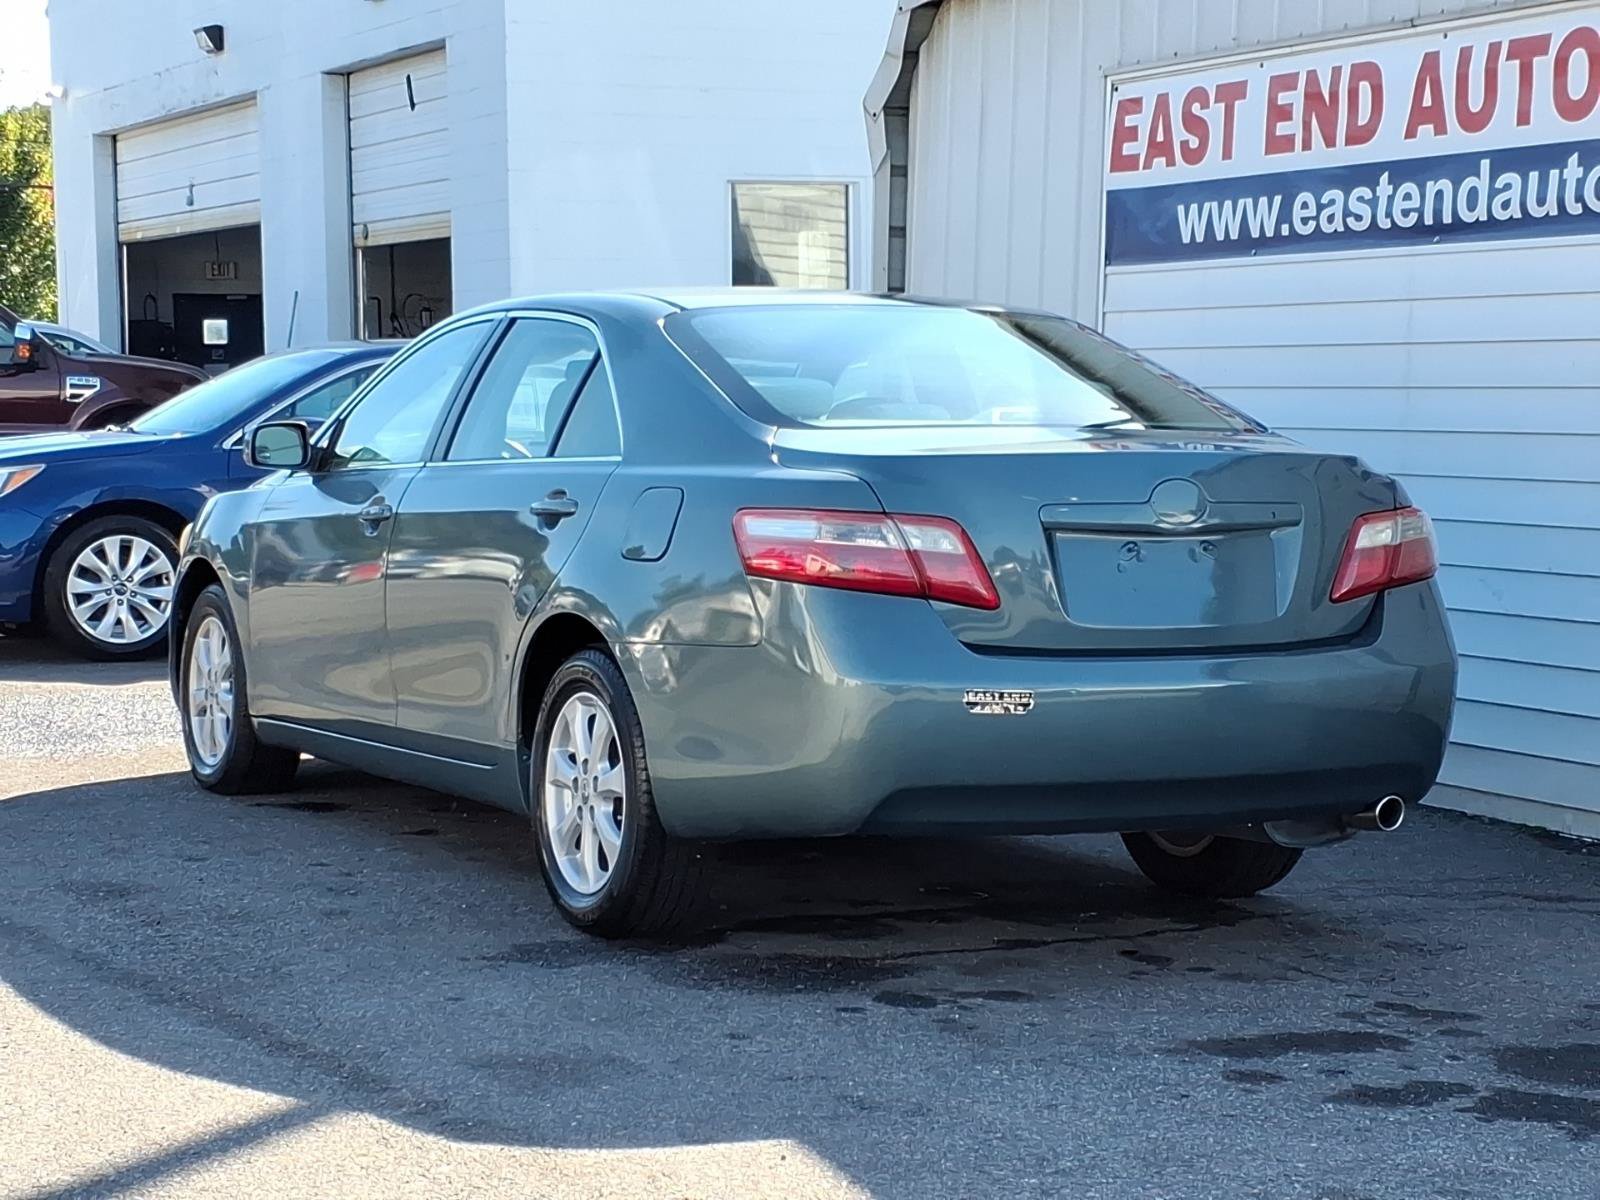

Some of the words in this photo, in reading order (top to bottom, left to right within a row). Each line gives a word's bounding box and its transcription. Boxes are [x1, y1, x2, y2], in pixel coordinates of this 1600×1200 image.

[1109, 79, 1248, 173] EAST
[1264, 60, 1384, 156] END
[1403, 26, 1600, 140] AUTO
